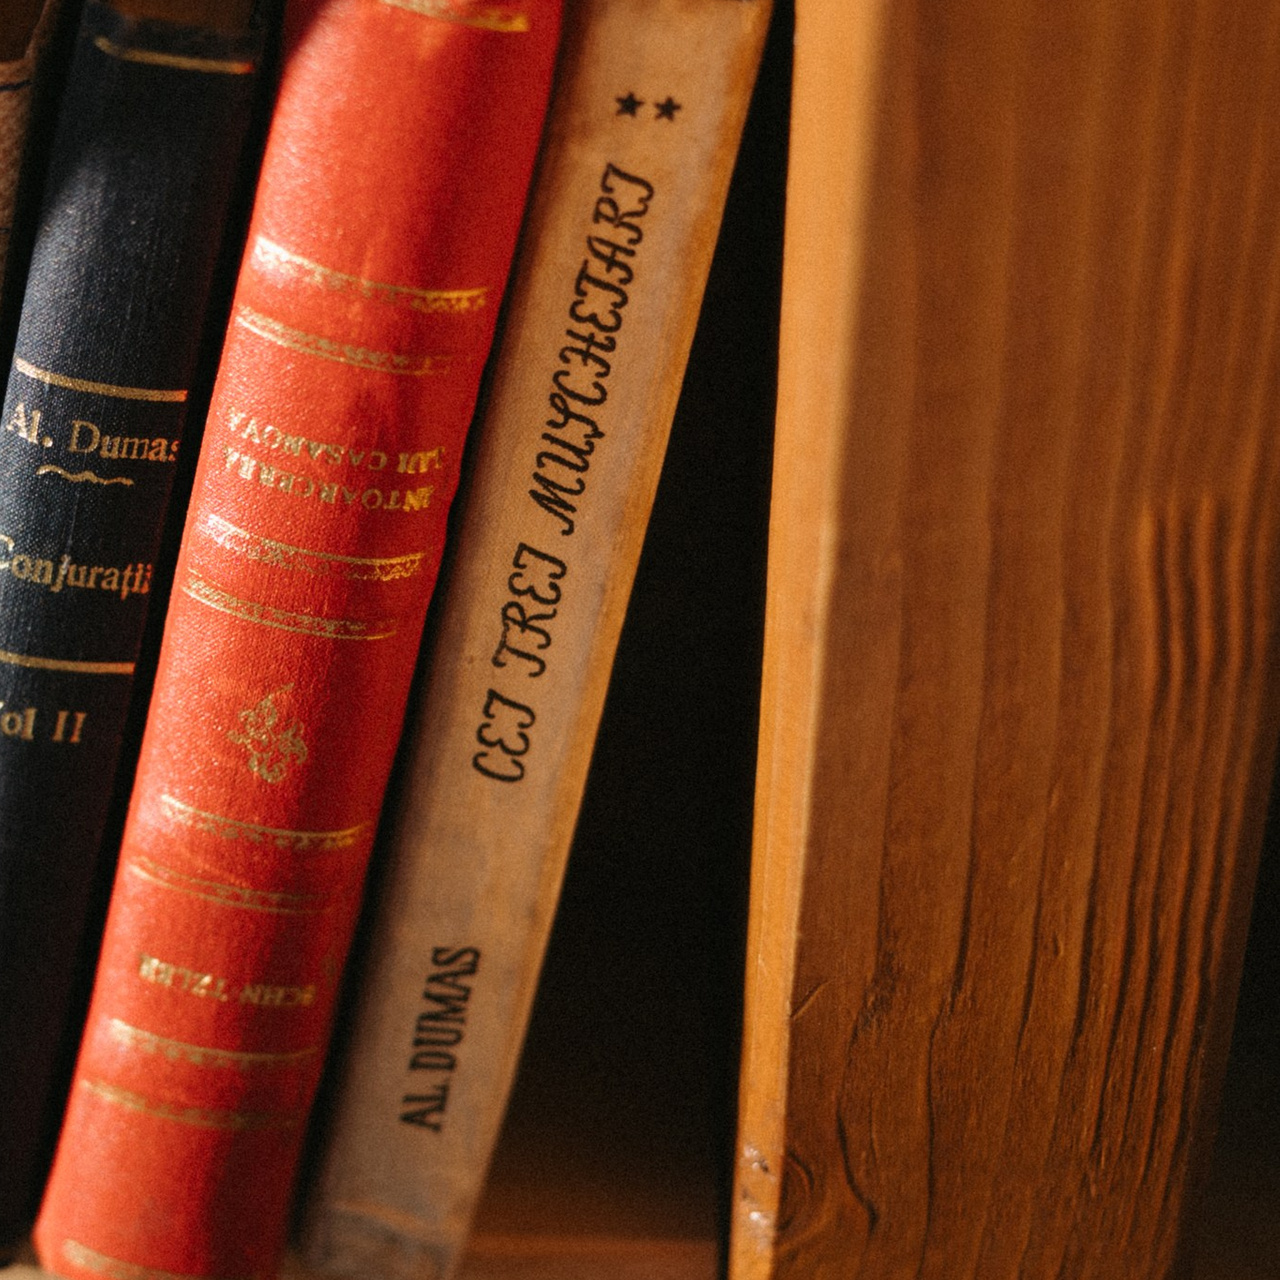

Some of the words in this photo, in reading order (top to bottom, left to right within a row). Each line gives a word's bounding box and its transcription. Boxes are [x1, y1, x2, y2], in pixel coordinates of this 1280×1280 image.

[6, 402, 54, 449] Al.
[226, 406, 388, 471] CASANOVA
[53, 711, 87, 743] II
[410, 947, 481, 1071] DUMAS
